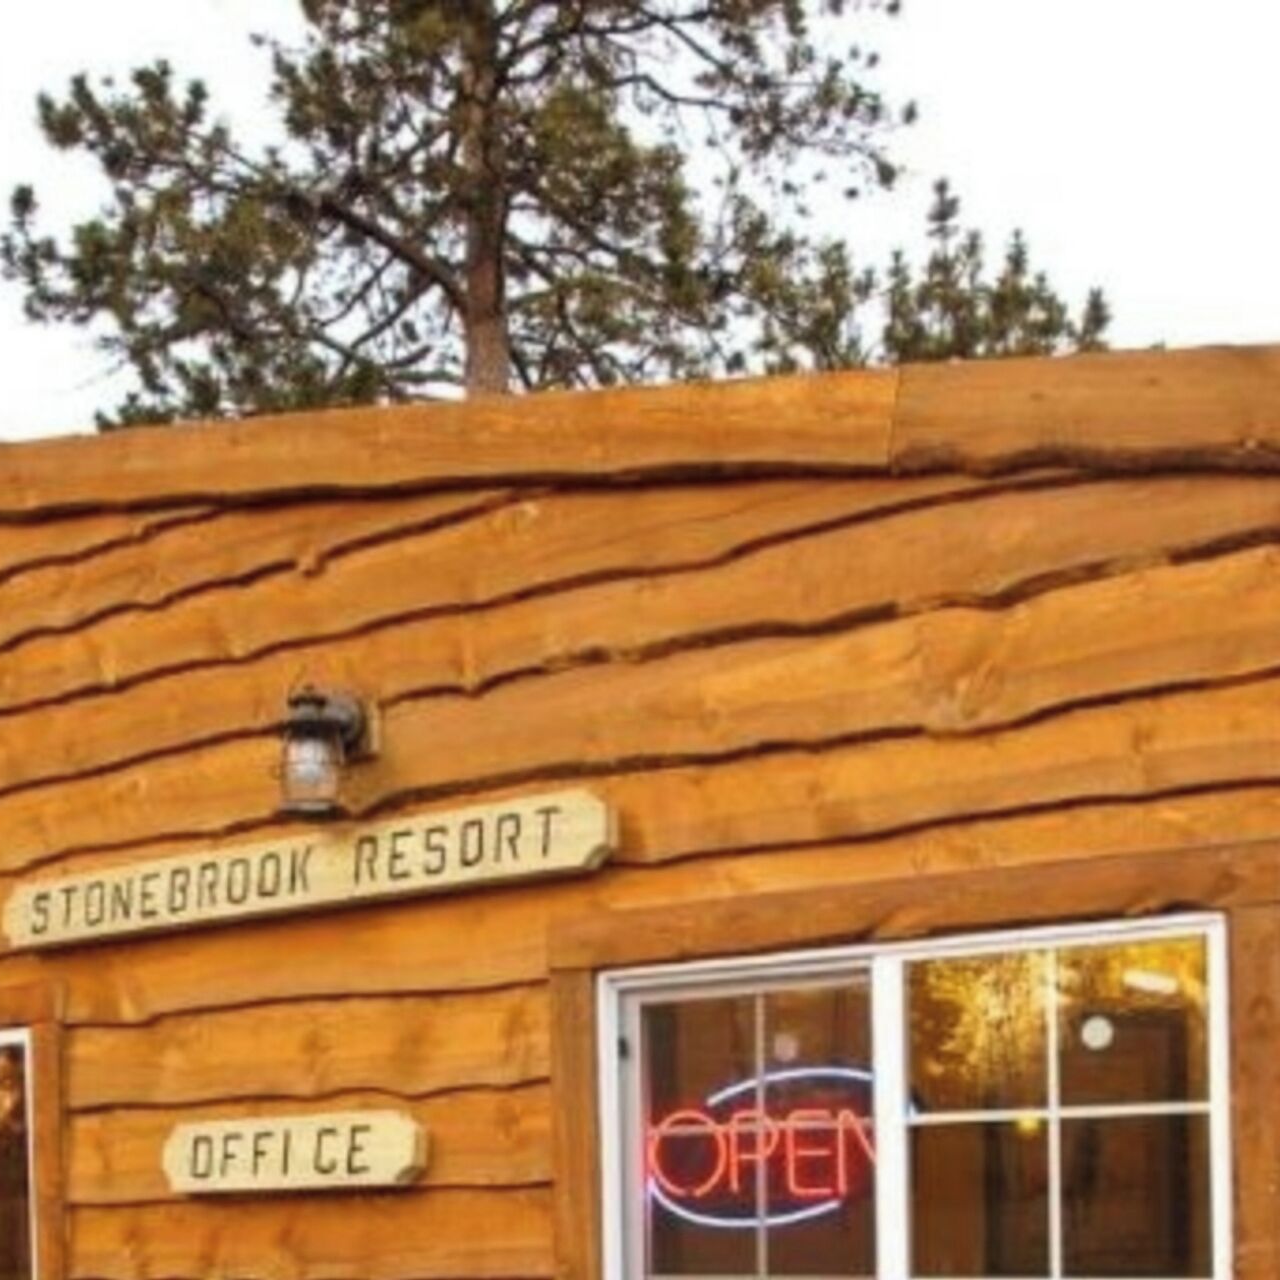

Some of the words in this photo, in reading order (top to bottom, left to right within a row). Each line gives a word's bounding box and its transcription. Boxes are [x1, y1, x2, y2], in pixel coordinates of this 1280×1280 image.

[29, 846, 314, 935] STONEBROOK
[353, 806, 562, 885] RESORT
[189, 1124, 371, 1181] OFFICE
